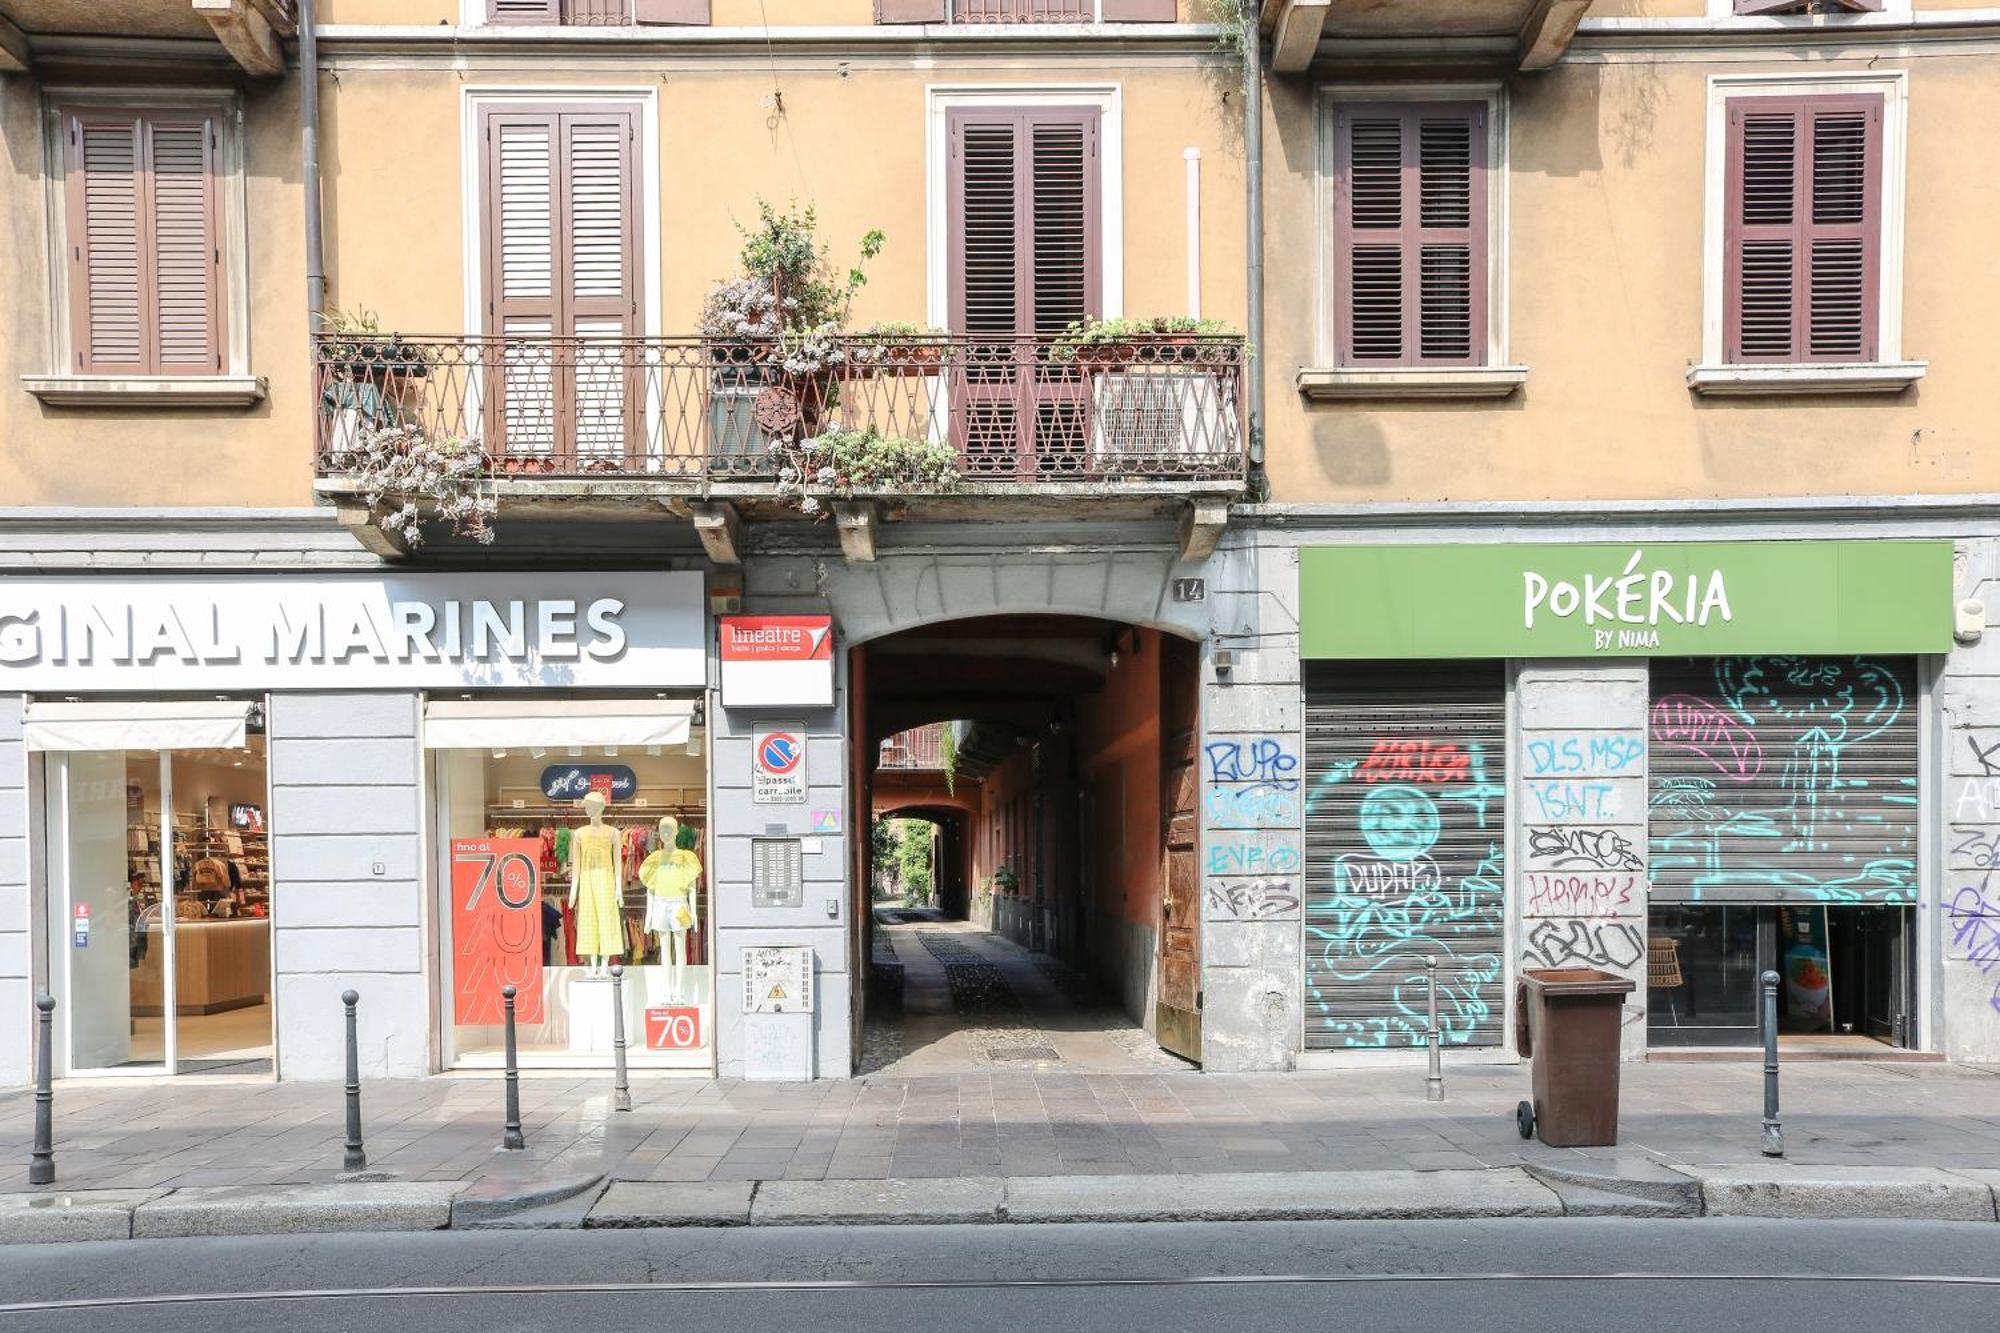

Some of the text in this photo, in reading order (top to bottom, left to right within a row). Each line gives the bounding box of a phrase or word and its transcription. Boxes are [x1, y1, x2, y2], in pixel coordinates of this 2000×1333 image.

[1178, 580, 1201, 601] 14
[1523, 549, 1732, 630] POKÉRIA
[264, 598, 629, 664] MARINES
[731, 626, 801, 643] lineatre
[1595, 630, 1661, 650] BY NIMA
[457, 841, 490, 851] fino al
